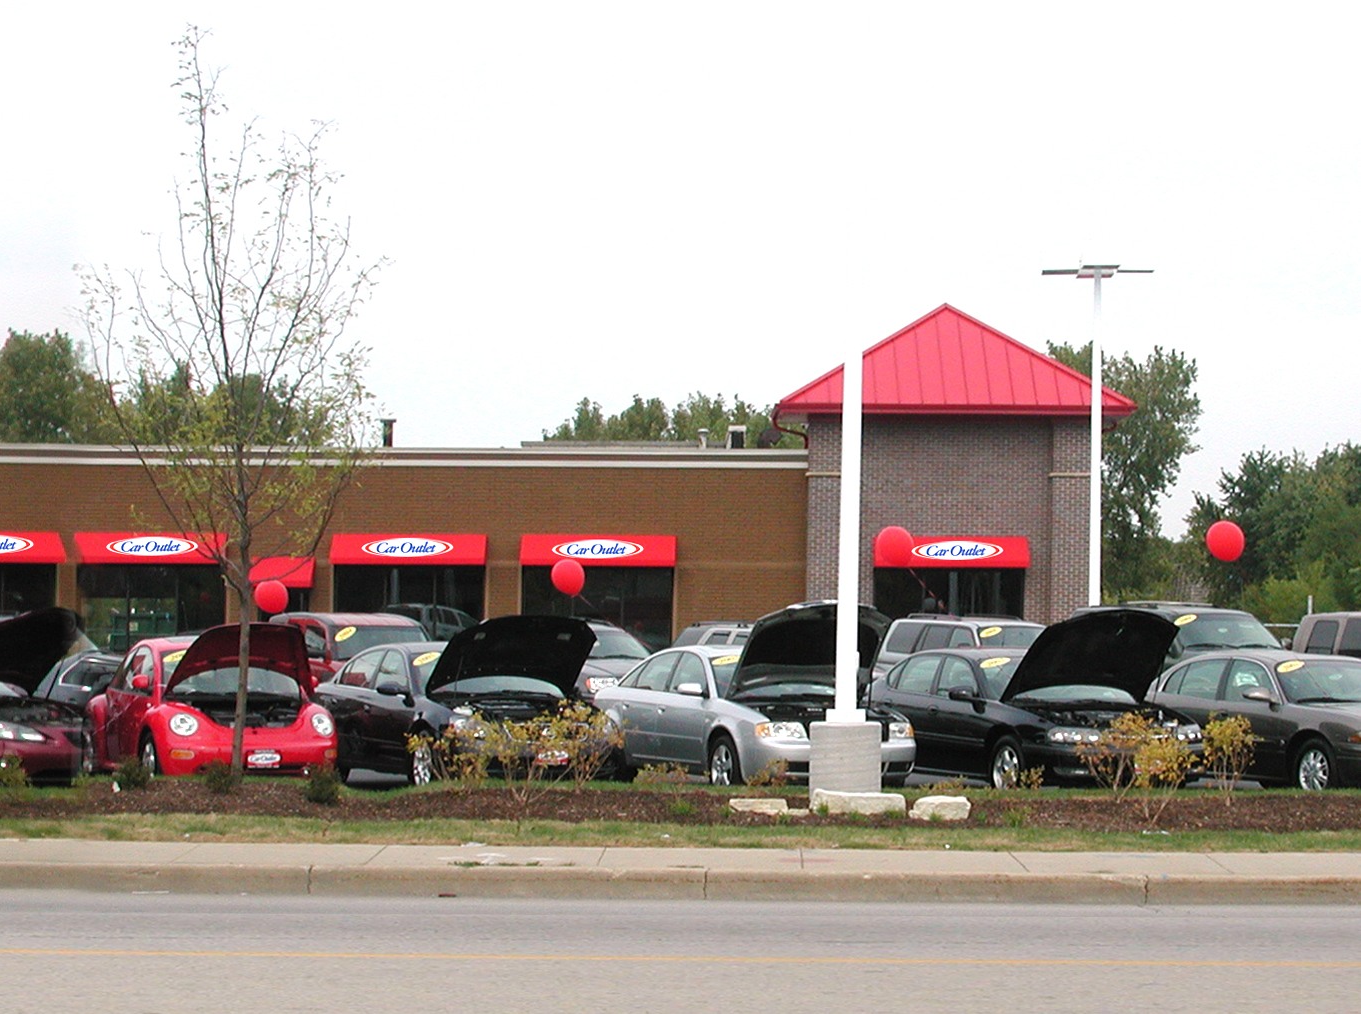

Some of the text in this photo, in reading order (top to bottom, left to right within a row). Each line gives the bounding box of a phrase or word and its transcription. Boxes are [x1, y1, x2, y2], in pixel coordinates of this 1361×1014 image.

[120, 540, 181, 553] Car Outlet
[376, 541, 437, 554] Car Outlet
[566, 542, 626, 555] Car Outlet
[925, 544, 986, 557] Car Outlet
